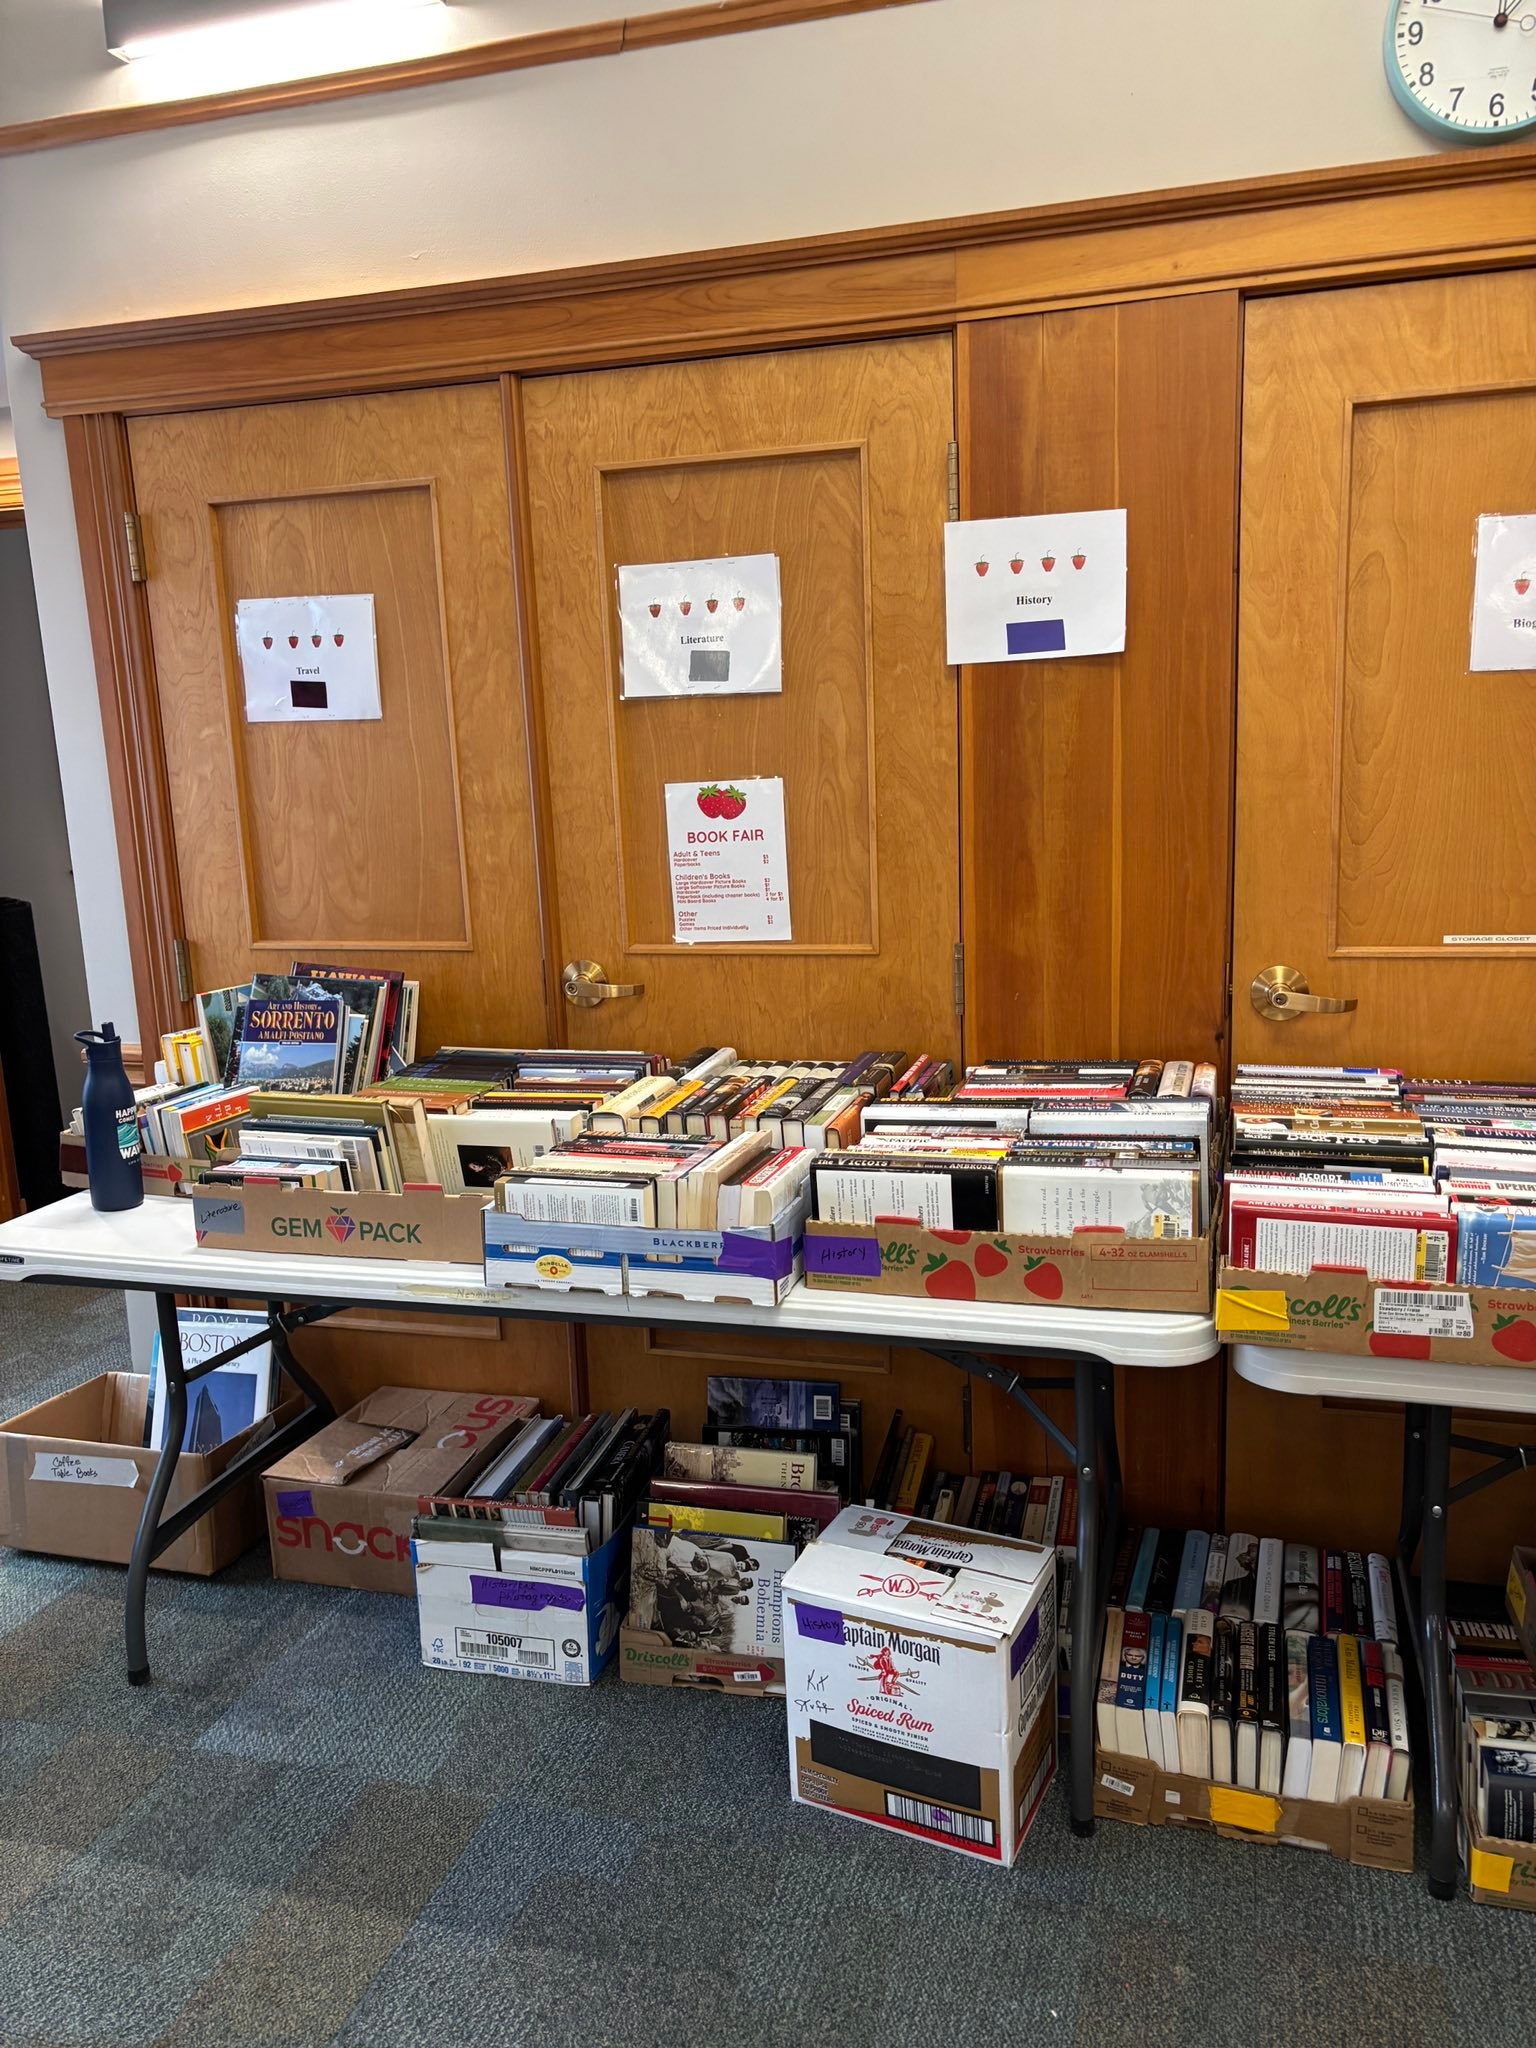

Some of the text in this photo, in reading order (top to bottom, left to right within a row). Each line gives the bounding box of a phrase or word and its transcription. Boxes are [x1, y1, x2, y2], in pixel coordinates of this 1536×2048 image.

[1408, 21, 1423, 45] 9
[1419, 62, 1434, 87] 8
[1449, 87, 1465, 112] 7
[1489, 93, 1504, 117] 6
[1016, 595, 1053, 605] History
[680, 635, 724, 645] Literature
[296, 666, 320, 675] Travel
[687, 829, 764, 843] BOOK FAIR
[675, 873, 708, 881] Children's
[250, 1010, 335, 1030] SORRENTO
[271, 1217, 422, 1244] GEM PACK
[821, 1246, 866, 1263] History
[880, 1241, 919, 1266] oll's
[1018, 1246, 1085, 1257] Strawberries
[1099, 1247, 1126, 1258] 4-32
[1139, 1251, 1188, 1259] CLAMSHELLS
[1289, 1294, 1536, 1321] coll's Strawb
[180, 1332, 253, 1354] BOSTON
[52, 1456, 81, 1468] Coffee
[51, 1468, 98, 1479] Table Books
[791, 1462, 805, 1490] Bro
[1347, 1552, 1366, 1579] RESOLVE
[755, 1578, 770, 1642] Bohemia
[802, 1617, 842, 1636] History
[485, 1633, 523, 1649] 105007
[843, 1622, 941, 1666] aptain Morgan
[1268, 1626, 1276, 1661] STOLEN LIVES
[431, 1656, 509, 1674] 20 92 5000
[625, 1647, 690, 1668] Driscoll's
[1120, 1673, 1144, 1682] DUTY
[1346, 1660, 1357, 1680] Malala
[905, 1677, 927, 1686] QUALITY
[870, 1695, 908, 1710] ORIGINAL
[847, 1698, 934, 1733] Spiced Rum
[851, 1717, 872, 1727] SPICED
[880, 1725, 905, 1736] SMOOTH
[907, 1732, 929, 1742] FINISH
